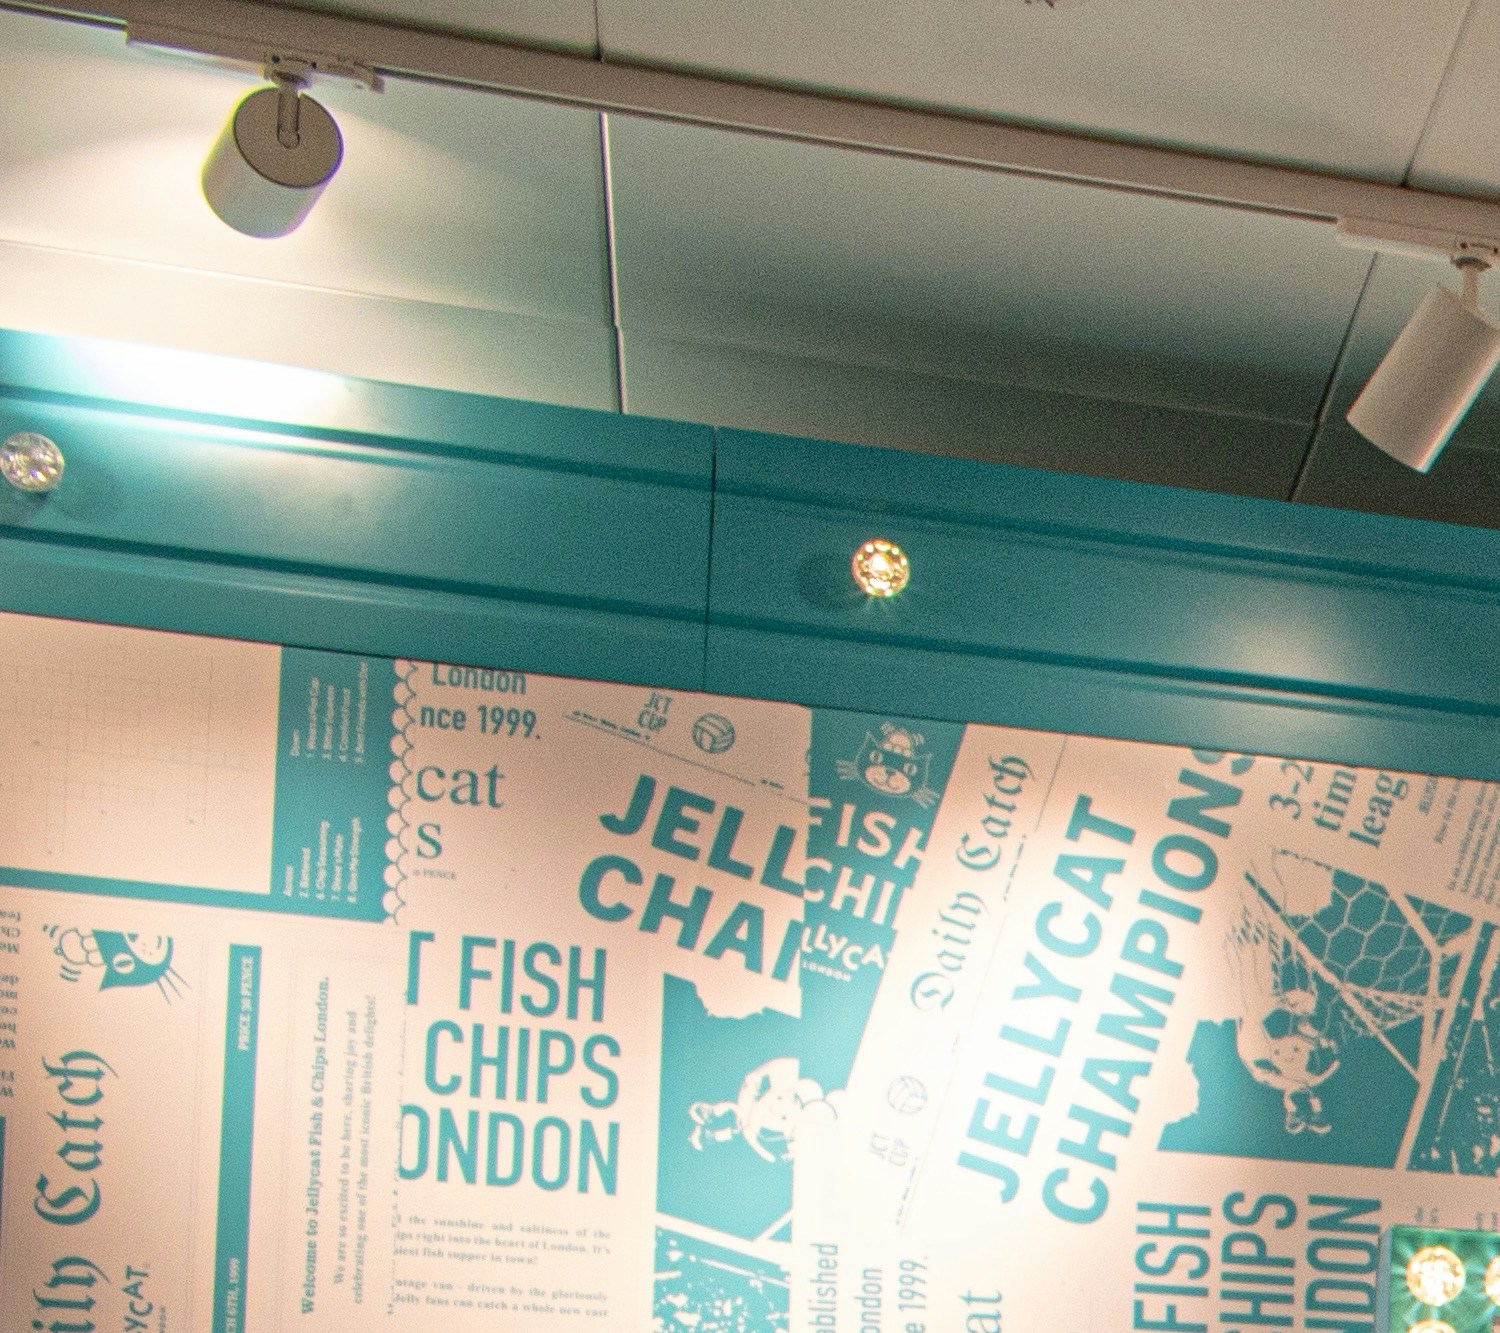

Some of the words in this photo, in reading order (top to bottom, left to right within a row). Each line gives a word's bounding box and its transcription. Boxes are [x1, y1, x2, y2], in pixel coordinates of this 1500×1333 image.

[476, 703, 541, 741] 1999.
[415, 764, 506, 809] cat
[909, 881, 991, 1013] Daily
[954, 753, 1035, 872] Catch
[313, 976, 331, 1043] London.
[460, 935, 607, 1022] FISH
[956, 793, 1138, 1203] JELLYCAT
[310, 1047, 329, 1093] Chips
[424, 1018, 621, 1109] CHIPS
[308, 1112, 325, 1147] Fish
[311, 1096, 325, 1108] &
[33, 1048, 119, 1227] Catch
[306, 1150, 324, 1216] Jellycat
[306, 1219, 320, 1237] to
[434, 1218, 486, 1231] sunshine
[491, 1222, 514, 1233] and
[519, 1224, 570, 1237] saltiness
[575, 1227, 589, 1239] of
[594, 1229, 612, 1241] the
[301, 1240, 319, 1314] Welcome
[898, 1254, 929, 1313] 1999.
